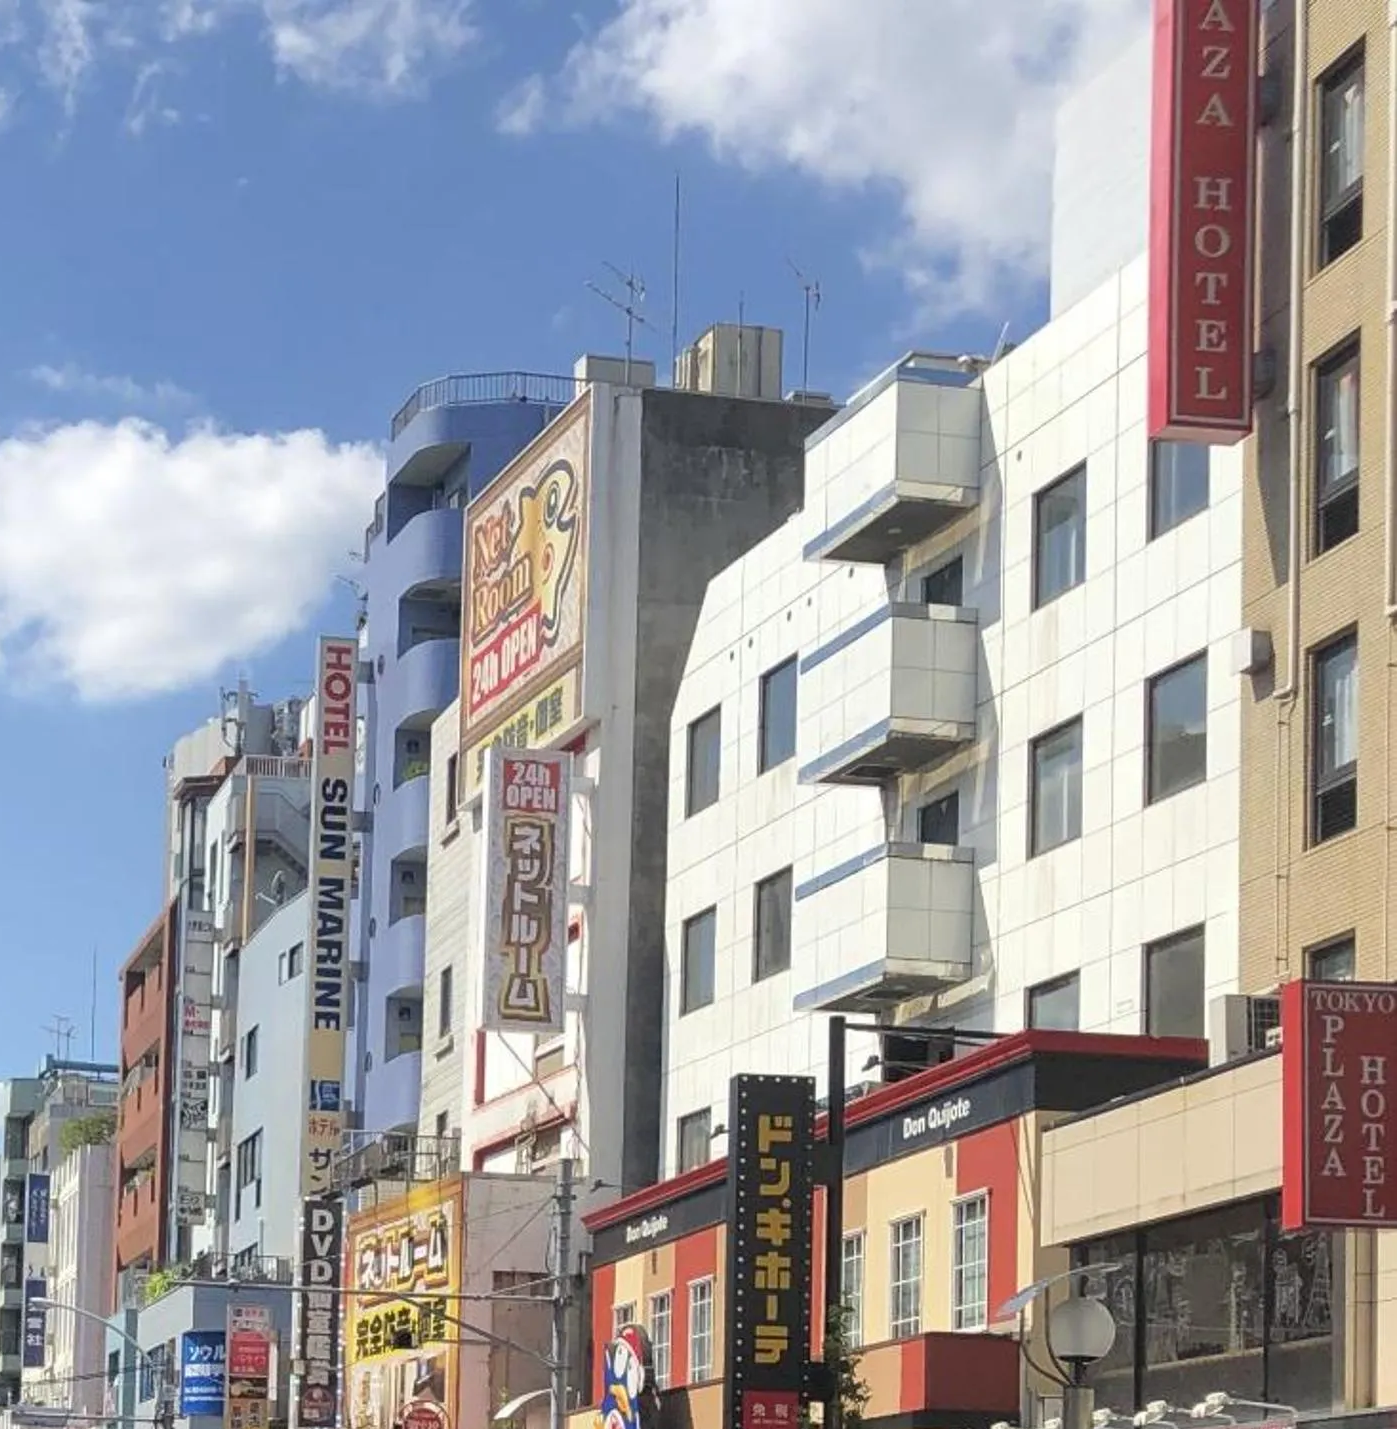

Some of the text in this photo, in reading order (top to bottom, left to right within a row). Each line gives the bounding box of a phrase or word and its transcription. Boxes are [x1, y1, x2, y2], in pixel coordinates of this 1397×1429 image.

[1194, 176, 1233, 401] HOTEL
[473, 499, 516, 579] Net
[473, 555, 533, 640] Room
[501, 613, 539, 686] OPEN
[506, 785, 555, 810] OPEN
[512, 761, 550, 786] 24h
[313, 646, 351, 1032] HOTEL SUN MARINE
[509, 826, 542, 1008] ネットルーム
[1311, 990, 1395, 1013] TOKYO
[903, 1097, 971, 1139] Don Quijote
[1321, 1015, 1346, 1177] PLAZA
[1360, 1056, 1386, 1218] HOTEL
[754, 1114, 792, 1364] ドン・キホーテ
